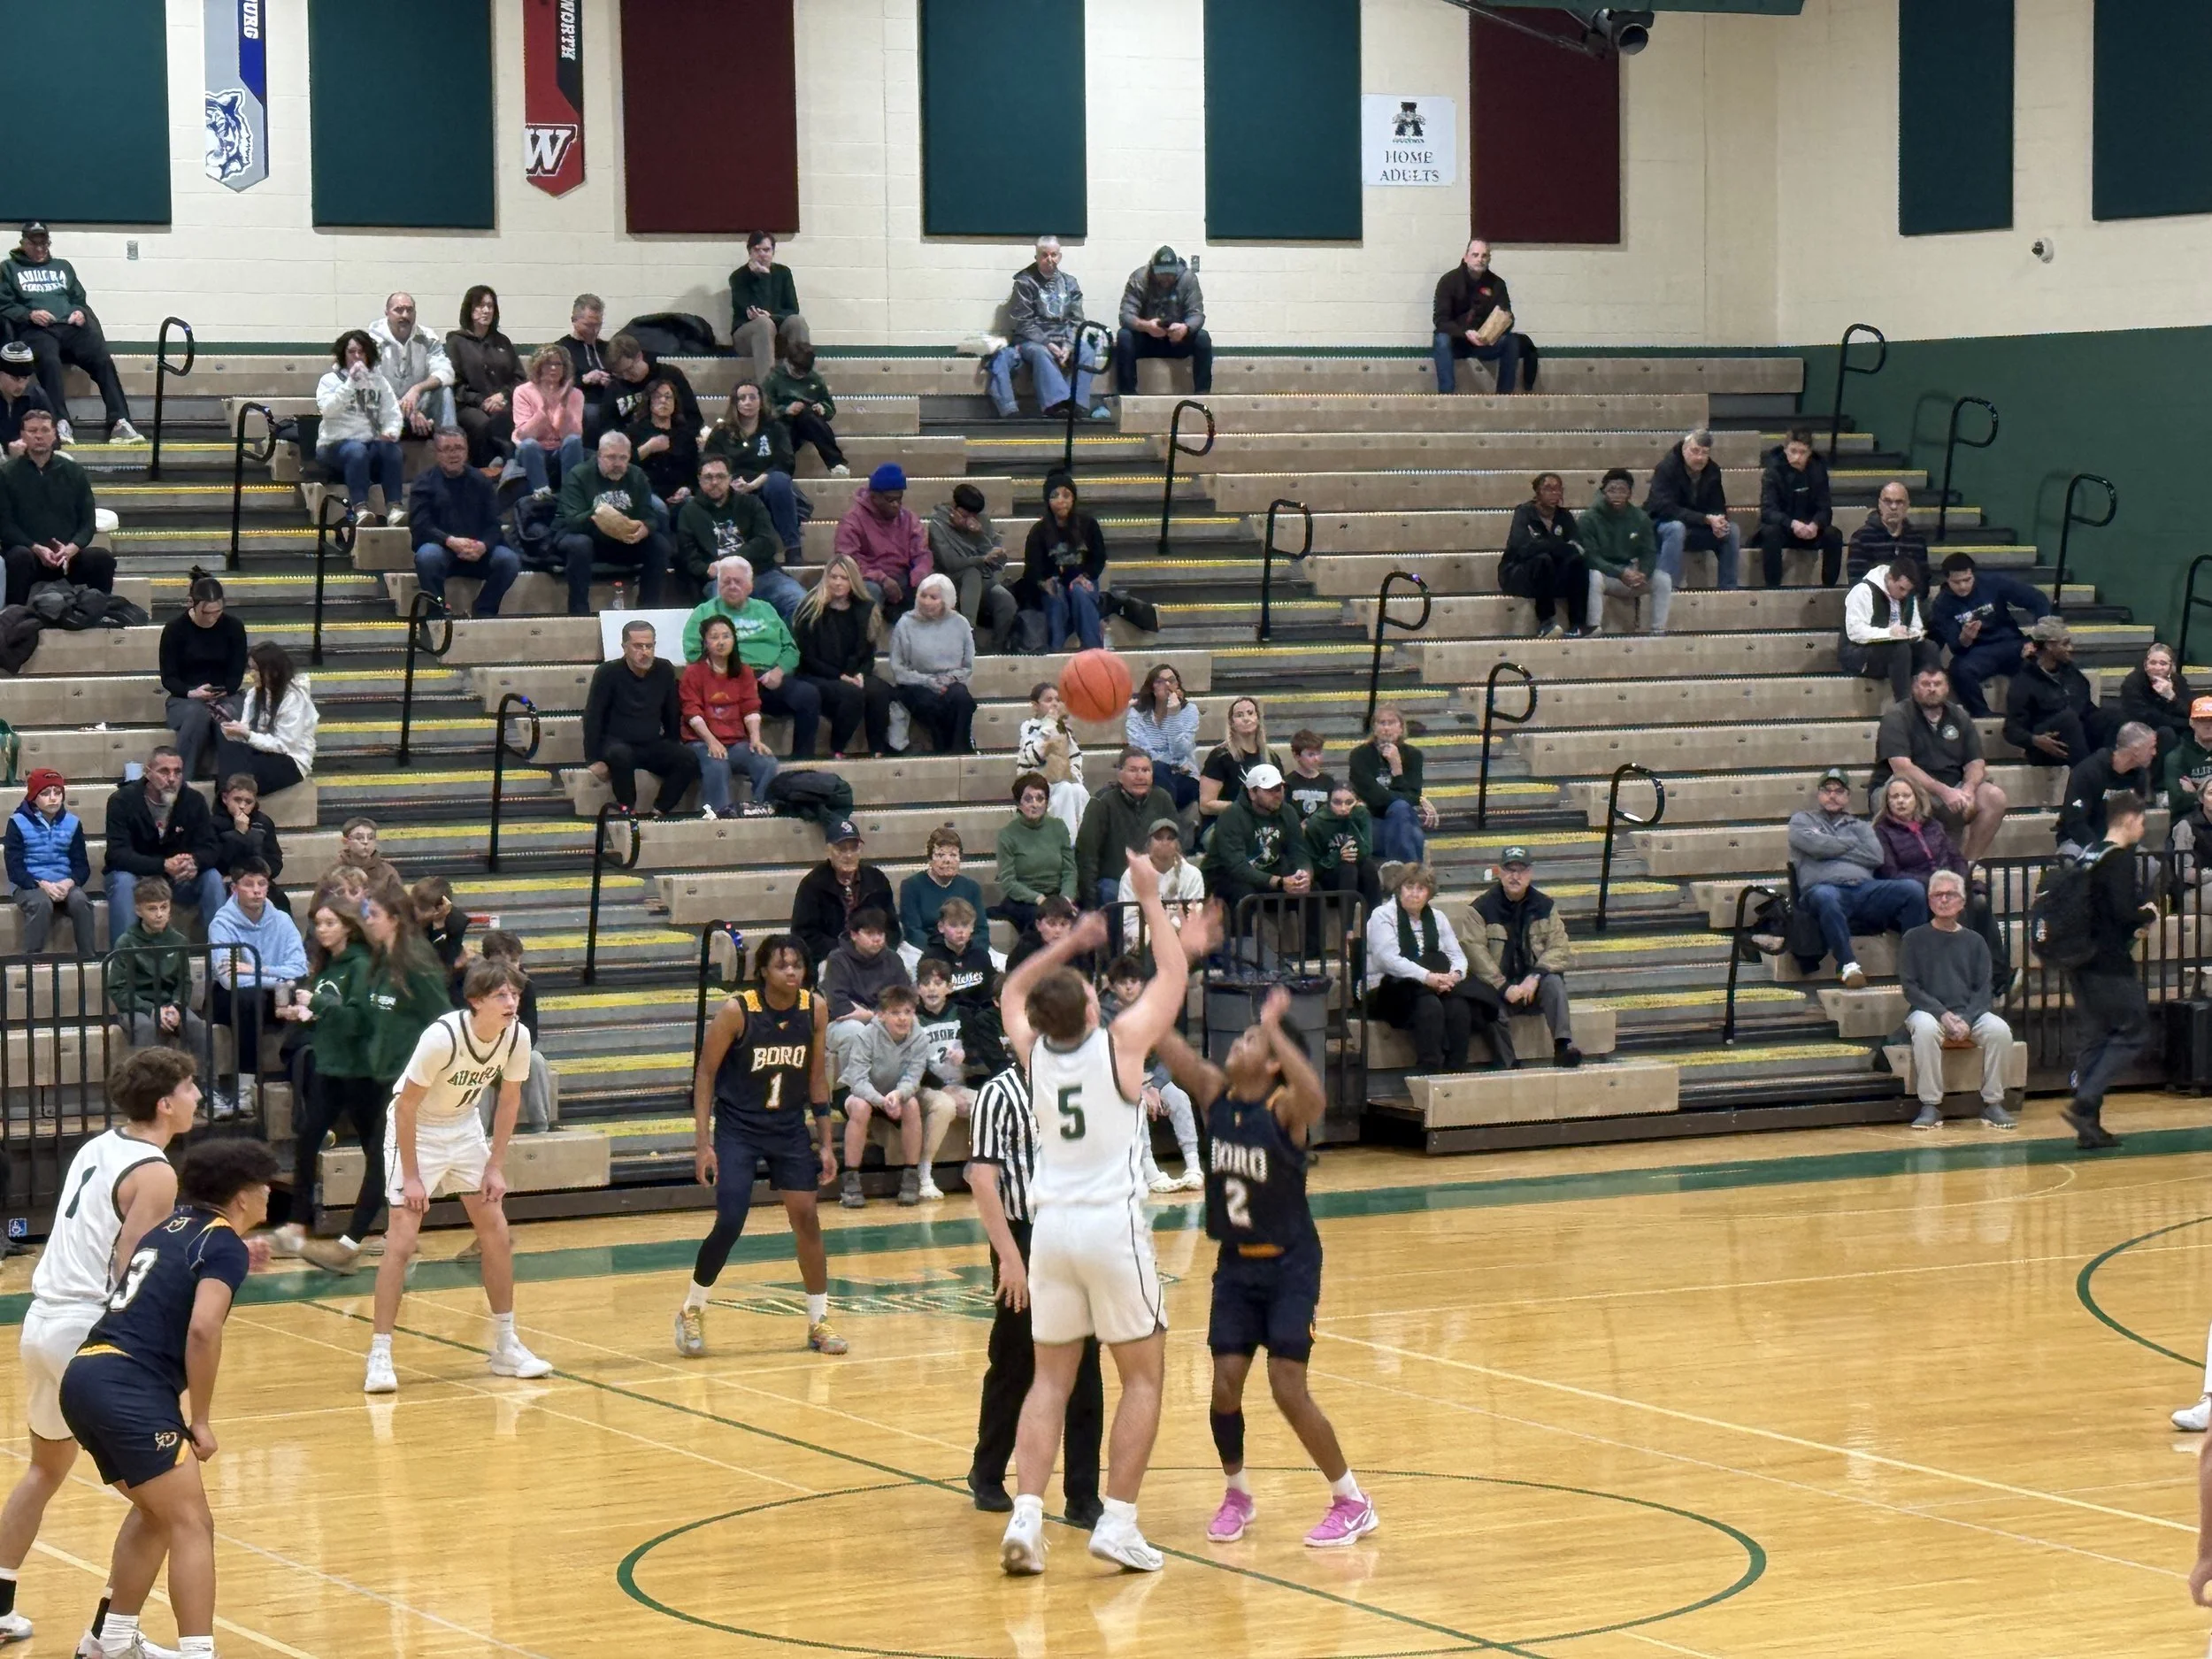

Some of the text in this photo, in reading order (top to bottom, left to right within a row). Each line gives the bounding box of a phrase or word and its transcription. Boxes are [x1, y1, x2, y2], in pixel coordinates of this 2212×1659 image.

[242, 0, 259, 39] URG
[1379, 168, 1440, 182] ADULTS
[1385, 150, 1433, 164] HOME
[750, 1045, 806, 1072] BORO
[455, 1087, 481, 1108] 11
[765, 1071, 782, 1109] 1
[1057, 1084, 1086, 1141] 5
[65, 1164, 96, 1219] 1
[1225, 1177, 1253, 1229] 2
[109, 1248, 158, 1311] 3
